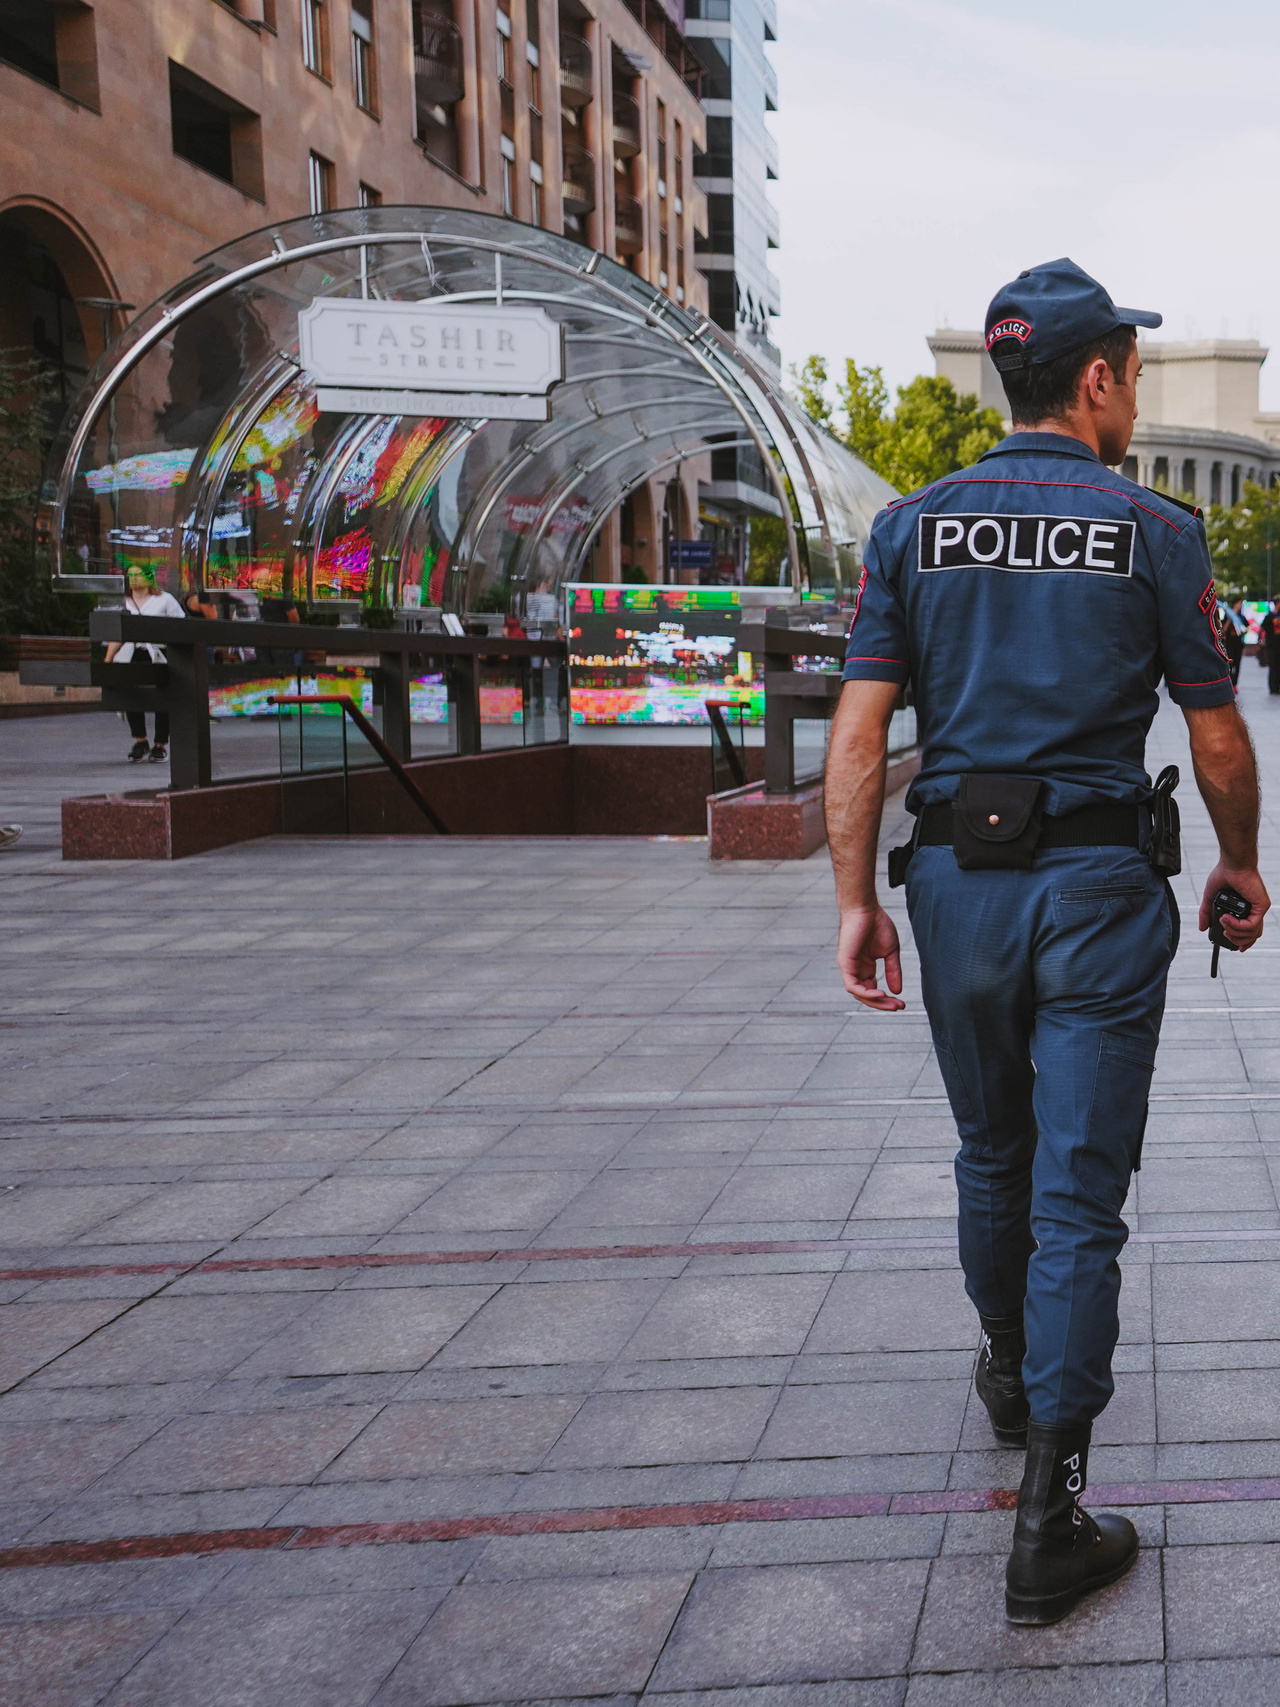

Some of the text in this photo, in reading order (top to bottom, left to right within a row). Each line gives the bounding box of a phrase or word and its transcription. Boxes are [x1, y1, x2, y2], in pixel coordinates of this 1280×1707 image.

[347, 322, 516, 351] TASHIR
[990, 323, 1026, 342] POLICE
[378, 354, 485, 369] STREET
[348, 395, 437, 411] SHOPPING
[934, 518, 1119, 569] POLICE
